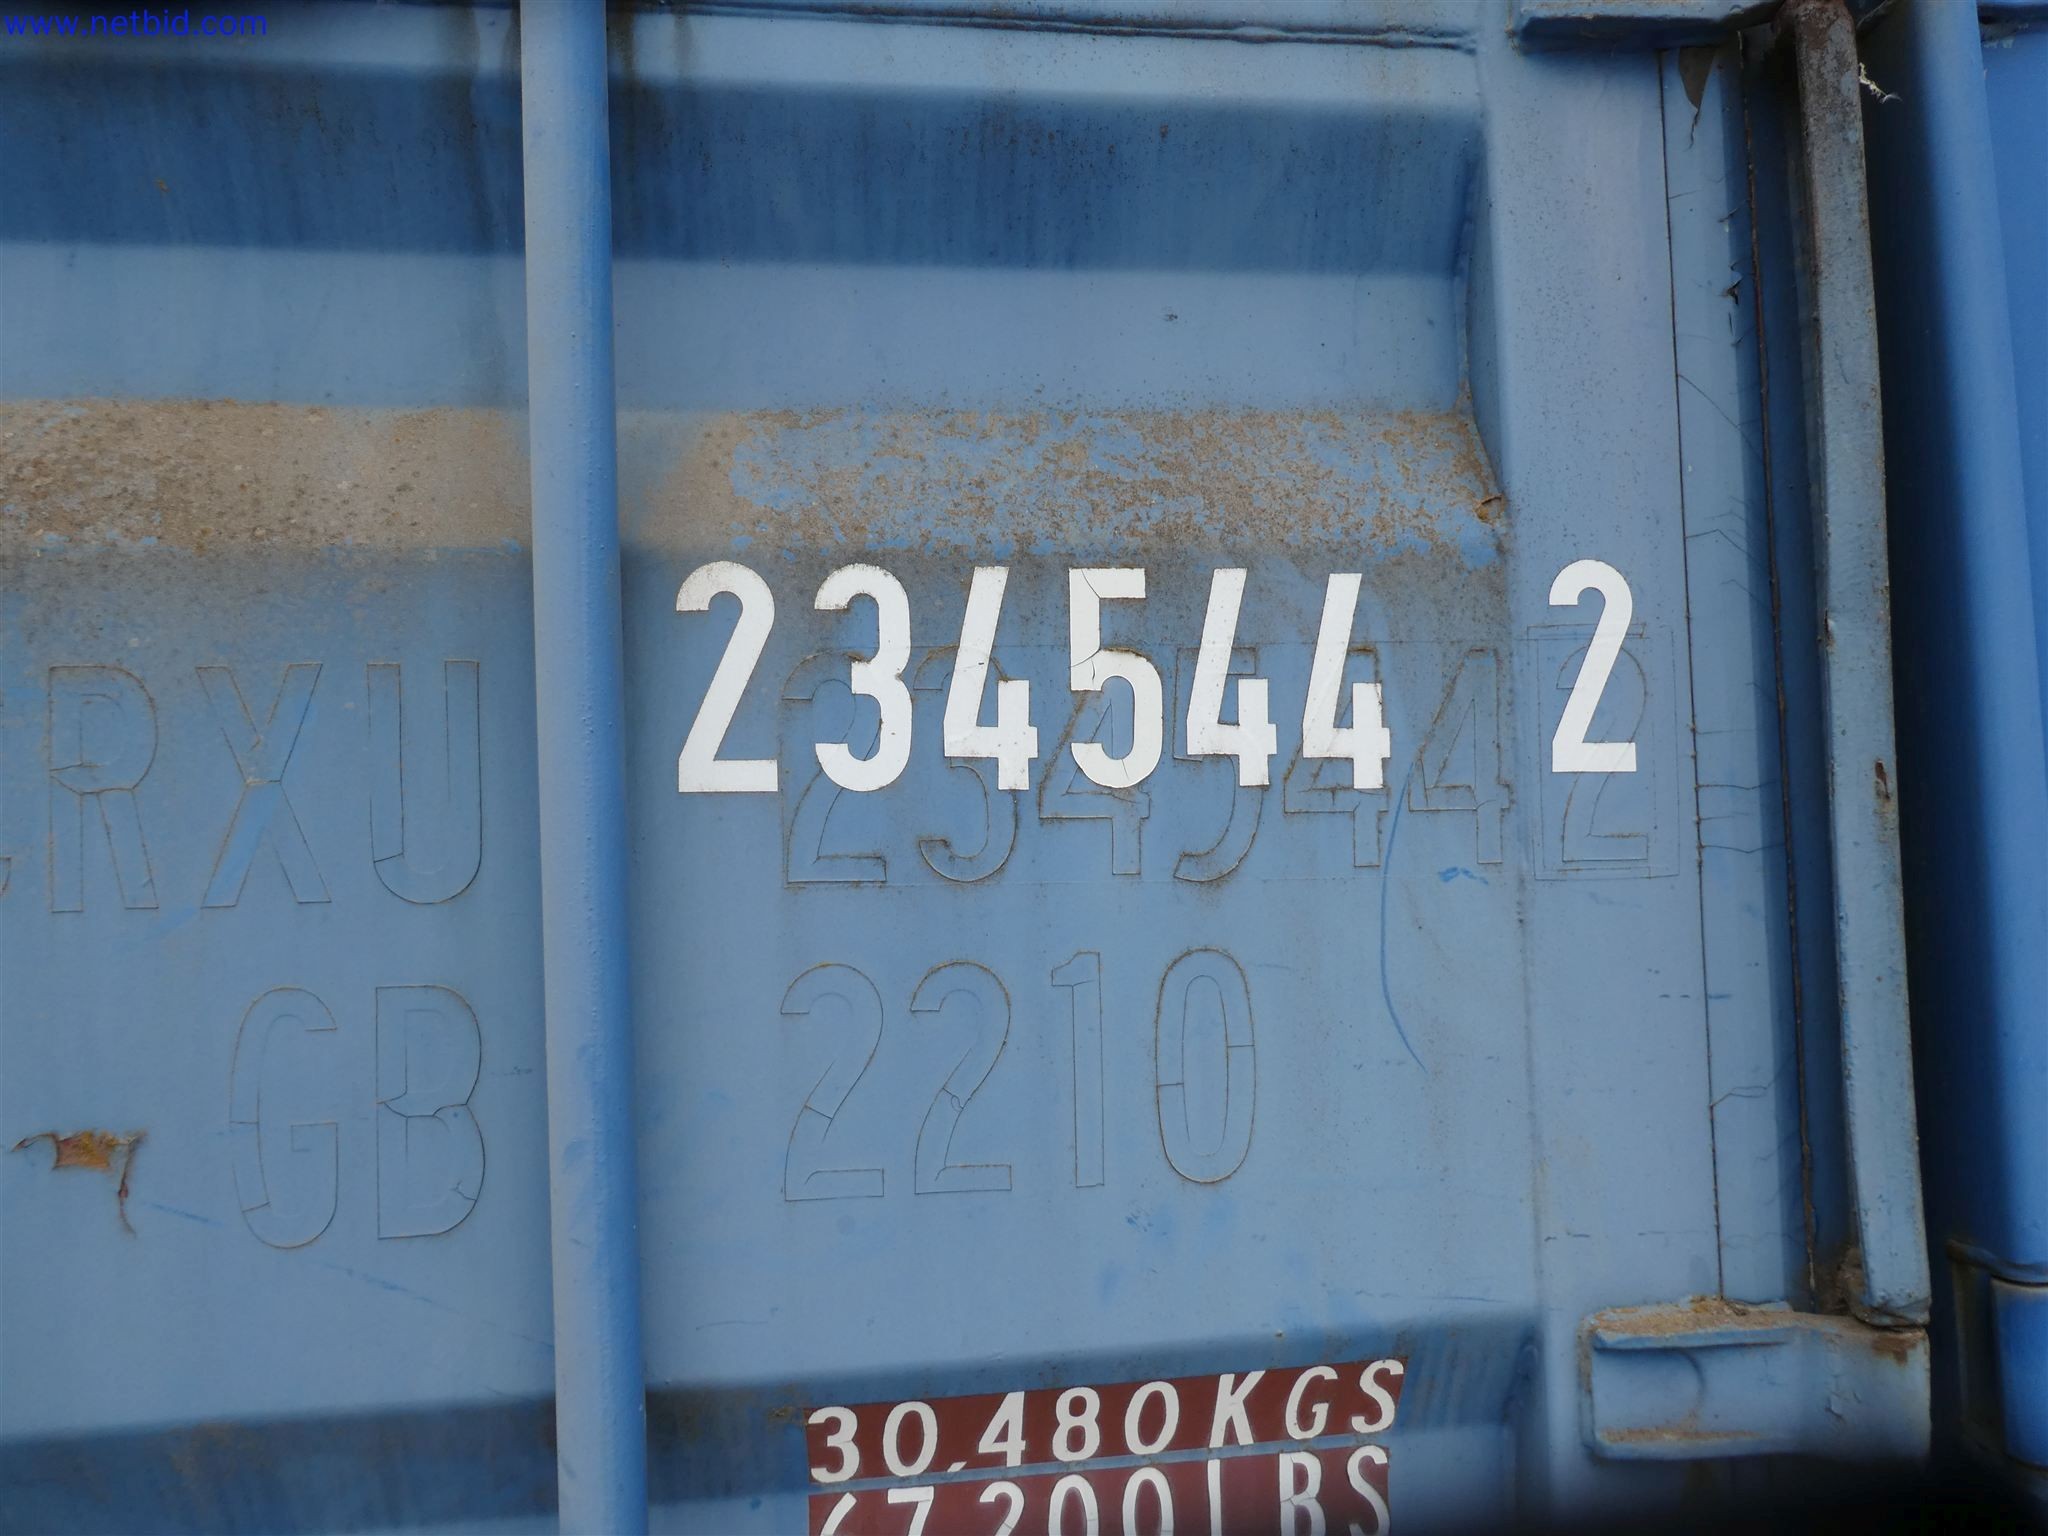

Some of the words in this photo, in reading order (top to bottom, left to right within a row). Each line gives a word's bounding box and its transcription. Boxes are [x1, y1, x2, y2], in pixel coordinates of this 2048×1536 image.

[0, 660, 482, 914] RXU
[676, 560, 1391, 793] 234544
[1548, 558, 1638, 773] 2
[229, 985, 486, 1249] GB
[780, 947, 1256, 1202] 2210
